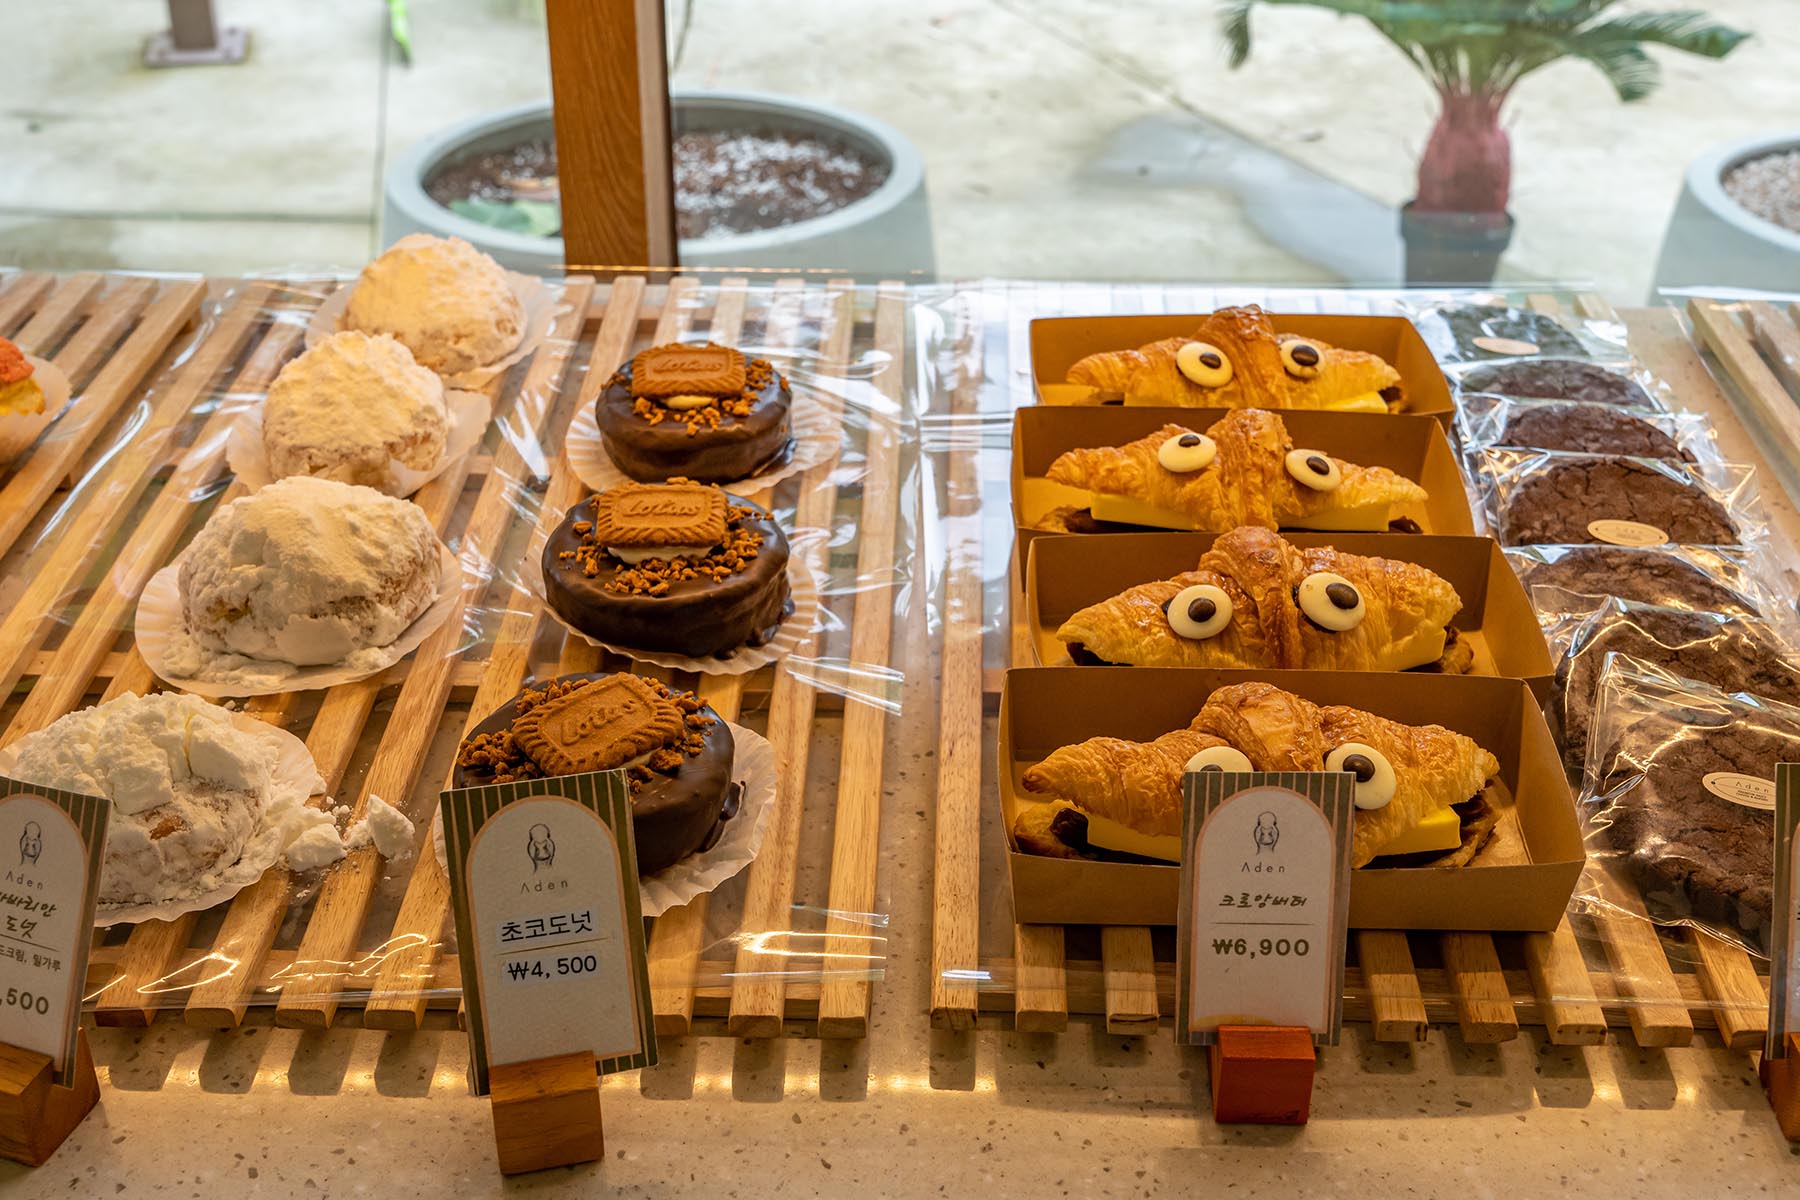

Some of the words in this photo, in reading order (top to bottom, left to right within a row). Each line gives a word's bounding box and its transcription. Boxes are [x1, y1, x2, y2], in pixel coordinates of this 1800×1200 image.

[622, 499, 701, 518] Lotus
[561, 699, 636, 746] Lotus
[1241, 862, 1285, 873] Aden
[5, 870, 43, 890] Aden
[520, 879, 569, 894] Aden
[6, 915, 38, 939] 도넛
[501, 910, 593, 943] 초코도넛
[1212, 938, 1310, 960] ₩6,900
